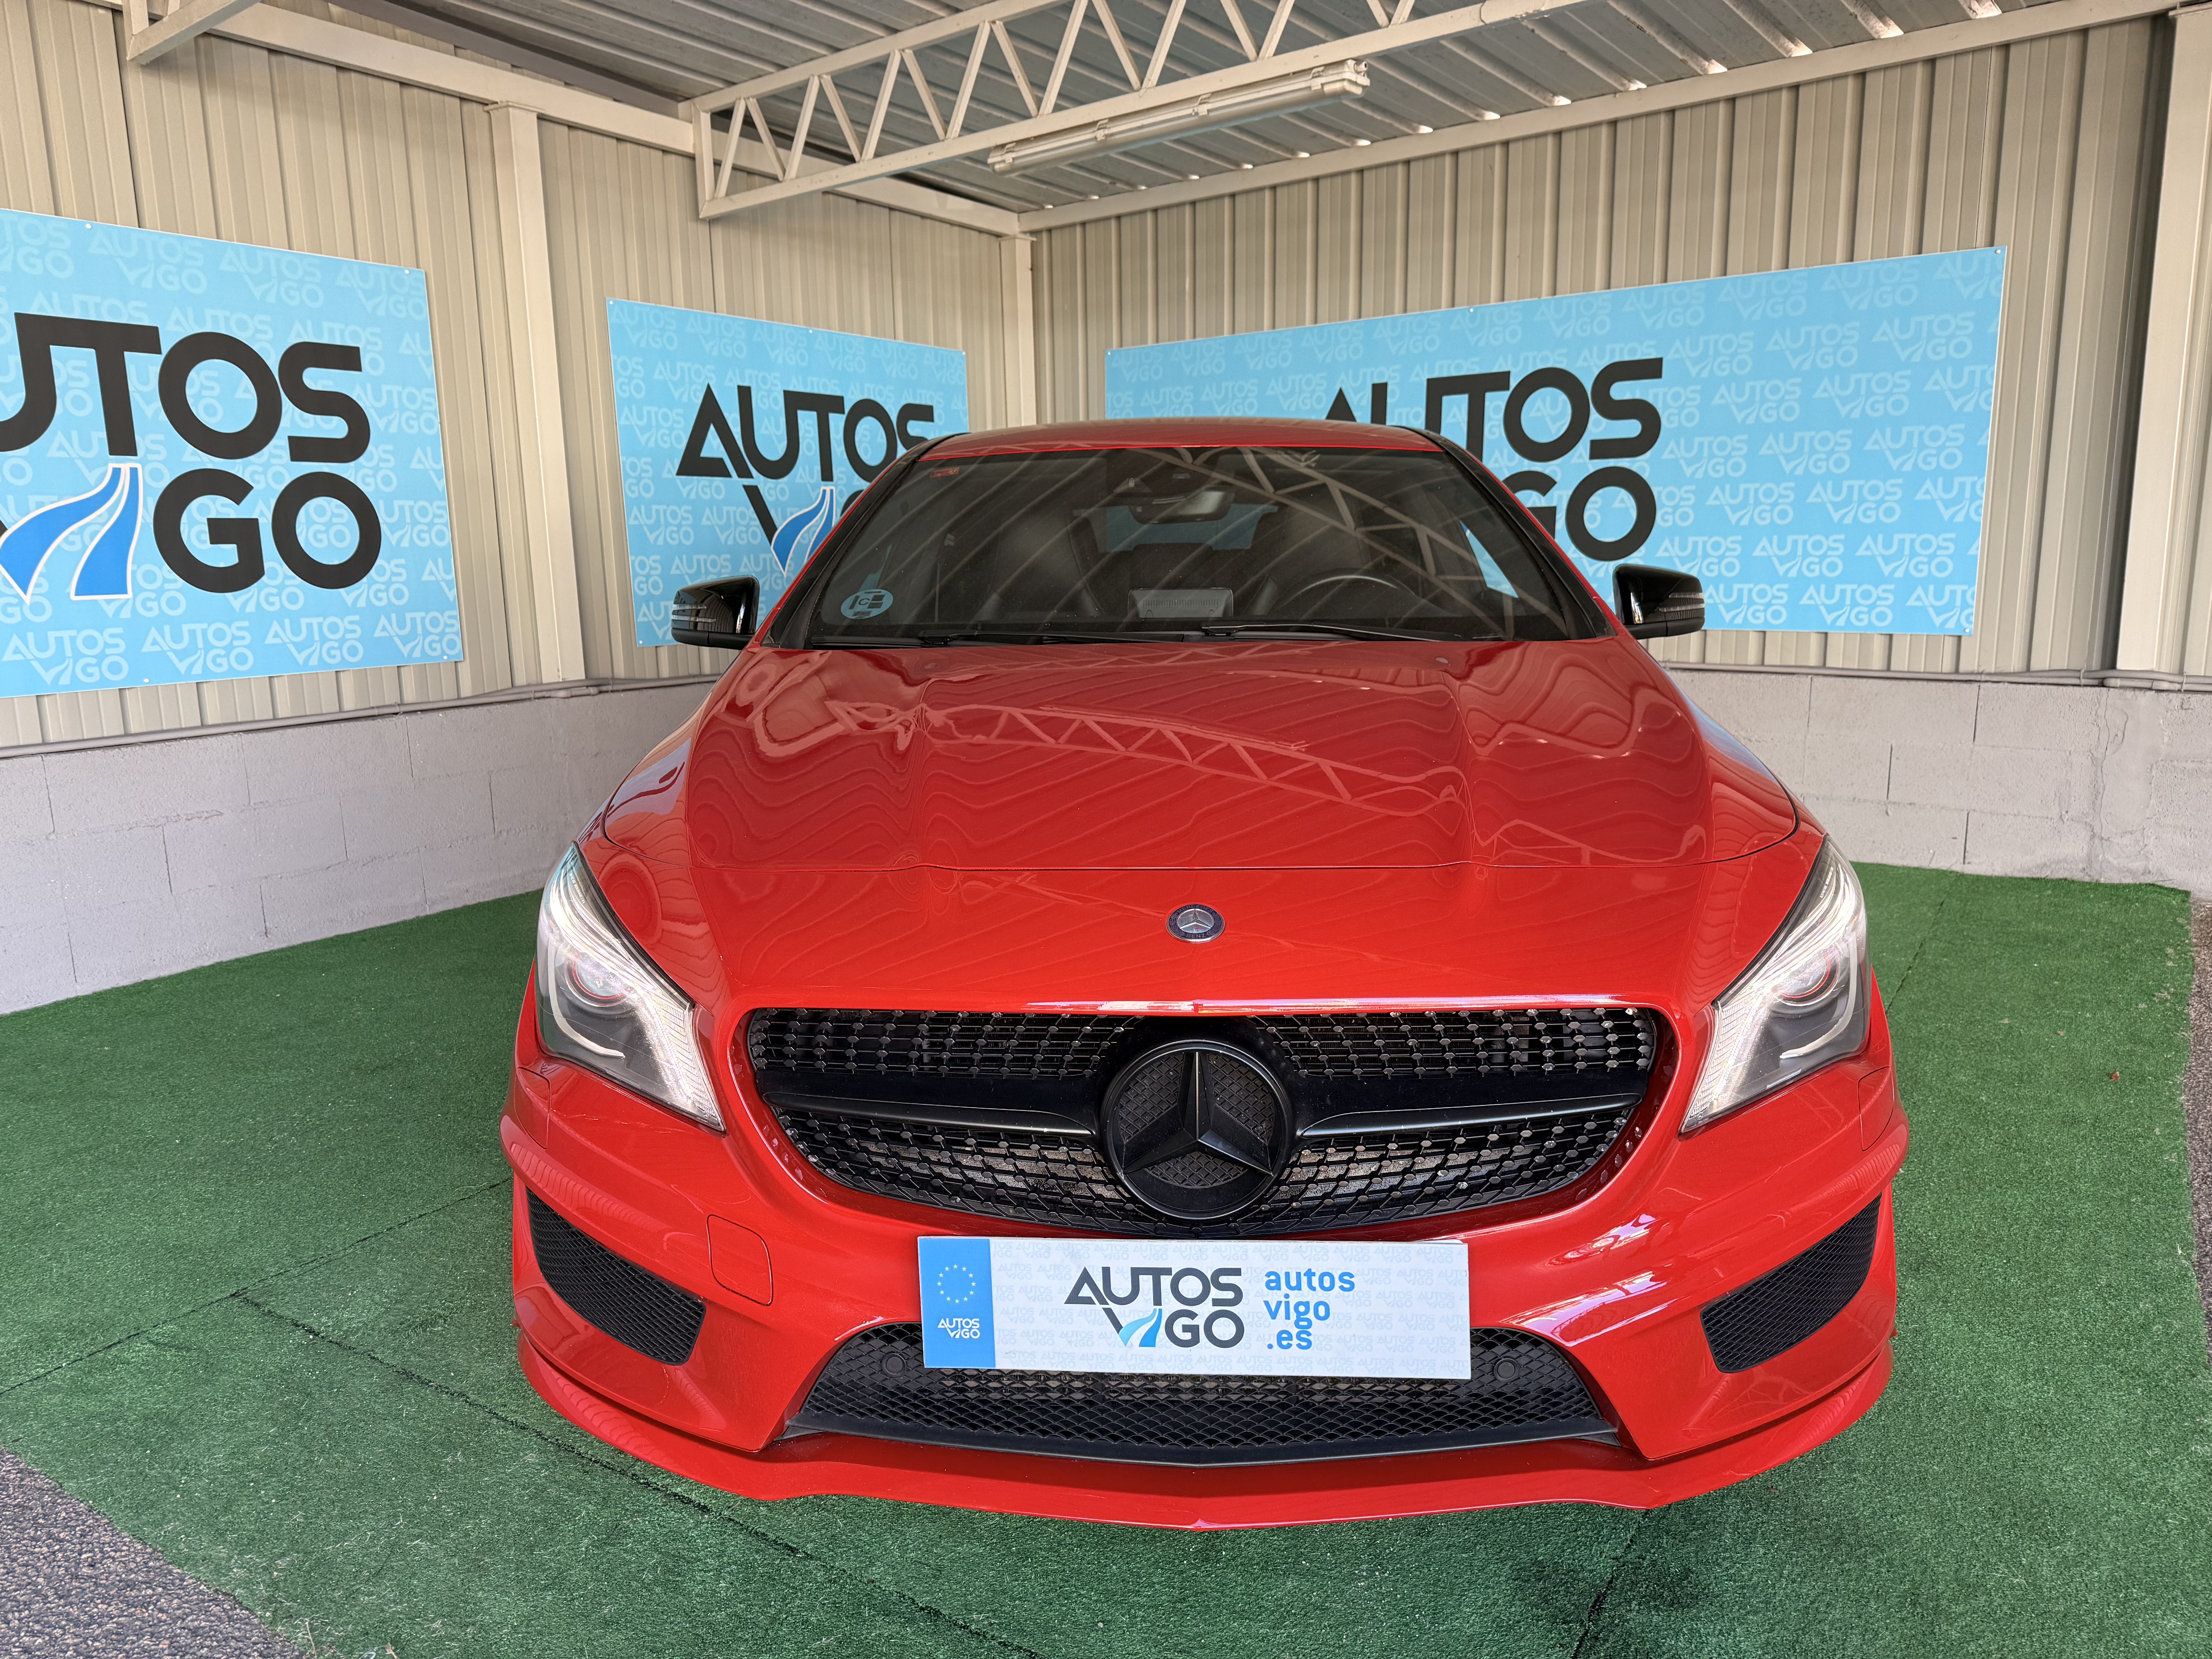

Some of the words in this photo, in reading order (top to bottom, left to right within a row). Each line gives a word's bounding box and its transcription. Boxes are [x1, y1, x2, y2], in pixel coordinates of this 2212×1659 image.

[88, 228, 204, 266] AUTOS
[117, 258, 207, 294] VIGO
[220, 247, 321, 283] AUTOS
[1822, 261, 1920, 292] AUTOS
[243, 272, 324, 308] VIGO
[335, 263, 423, 295] AUTOS
[1718, 272, 1807, 302] AUTOS
[28, 291, 150, 324] AUTOS
[356, 288, 427, 320] VIGO
[1534, 294, 1611, 322] AUTOS
[1624, 284, 1707, 310] AUTOS
[1736, 295, 1807, 321] VIGO
[1841, 284, 1918, 310] VIGO
[166, 307, 273, 341] AUTOS
[611, 305, 676, 330] AUTOS
[686, 315, 745, 339] AUTOS
[1374, 314, 1441, 338] AUTOS
[1449, 305, 1523, 329] AUTOS
[1549, 315, 1611, 339] VIGO
[1641, 308, 1705, 330] VIGO
[1872, 312, 1975, 341] AUTOS
[287, 320, 383, 353] AUTOS
[753, 323, 807, 347] AUTOS
[815, 333, 865, 355] AUTOS
[1234, 333, 1292, 354] AUTOS
[1302, 325, 1363, 346] AUTOS
[1387, 334, 1440, 355] VIGO
[1463, 325, 1522, 347] VIGO
[1666, 331, 1753, 360] AUTOS
[1765, 322, 1859, 351] AUTOS
[872, 342, 916, 361] AUTOS
[923, 350, 963, 368] AUTOS
[1111, 349, 1162, 368] AUTOS
[1169, 340, 1225, 362] AUTOS
[1245, 351, 1292, 370] VIGO
[1316, 343, 1364, 362] VIGO
[1784, 345, 1859, 370] VIGO
[1891, 337, 1972, 362] VIGO
[1123, 365, 1162, 382] VIGO
[1182, 357, 1226, 376] VIGO
[1684, 355, 1752, 378] VIGO
[1200, 380, 1258, 400] AUTOS
[1266, 373, 1327, 395] AUTOS
[1712, 378, 1802, 404] AUTOS
[1812, 370, 1911, 398] AUTOS
[350, 383, 436, 410] AUTOS
[1140, 386, 1194, 406] AUTOS
[1213, 398, 1258, 416] VIGO
[1279, 392, 1326, 411] VIGO
[1832, 393, 1910, 418] VIGO
[368, 407, 439, 435] VIGO
[620, 405, 684, 428] AUTOS
[1152, 403, 1194, 417] VIGO
[1731, 400, 1800, 424] VIGO
[1661, 434, 1748, 460] AUTOS
[1759, 429, 1852, 455] AUTOS
[1863, 424, 1965, 451] AUTOS
[1681, 458, 1746, 479] VIGO
[1778, 452, 1851, 475] VIGO
[1883, 448, 1963, 472] VIGO
[1705, 482, 1795, 505] AUTOS
[1806, 479, 1903, 503] AUTOS
[380, 500, 448, 524] UTOS
[629, 505, 692, 525] AUTOS
[1723, 504, 1794, 526] VIGO
[1825, 501, 1901, 524] VIGO
[1655, 536, 1741, 557] AUTOS
[1752, 534, 1845, 556] AUTOS
[1855, 533, 1956, 556] AUTOS
[1674, 556, 1741, 577] VIGO
[1771, 556, 1843, 577] VIGO
[1876, 555, 1953, 578] VIGO
[1704, 583, 1789, 605] AUTOS
[1799, 584, 1895, 605] AUTOS
[373, 610, 459, 637] AUTOS
[1719, 604, 1787, 625] VIGO
[1819, 605, 1893, 627] VIGO
[141, 620, 251, 653] AUTOS
[264, 616, 361, 644] AUTOS
[2, 627, 126, 661] AUTOS
[287, 640, 363, 666] VIGO
[393, 634, 462, 658] VIGO
[29, 655, 129, 685] VIGO
[167, 647, 254, 675] VIGO
[1016, 1242, 1050, 1251] AUTOS
[1055, 1243, 1090, 1252] AUTOS
[1095, 1243, 1128, 1252] AUTOS
[1133, 1244, 1168, 1252] AUTOS
[1173, 1245, 1208, 1253] AUTOS
[1212, 1245, 1248, 1253] AUTOS
[1252, 1245, 1288, 1253] AUTOS
[1293, 1245, 1329, 1254] AUTOS
[1334, 1246, 1370, 1254] AUTOS
[1374, 1246, 1411, 1255] AUTOS
[1417, 1247, 1453, 1255] AUTOS
[1064, 1266, 1243, 1307] AUTOS
[1265, 1269, 1355, 1292] autos
[1263, 1293, 1330, 1329] vigo
[938, 1318, 979, 1328] AUTOS
[946, 1328, 980, 1339] VIGO
[1102, 1307, 1245, 1348] VIGO
[1267, 1330, 1312, 1350] .es
[1041, 1352, 1075, 1360] AUTOS
[1317, 1357, 1353, 1365] AUTOS
